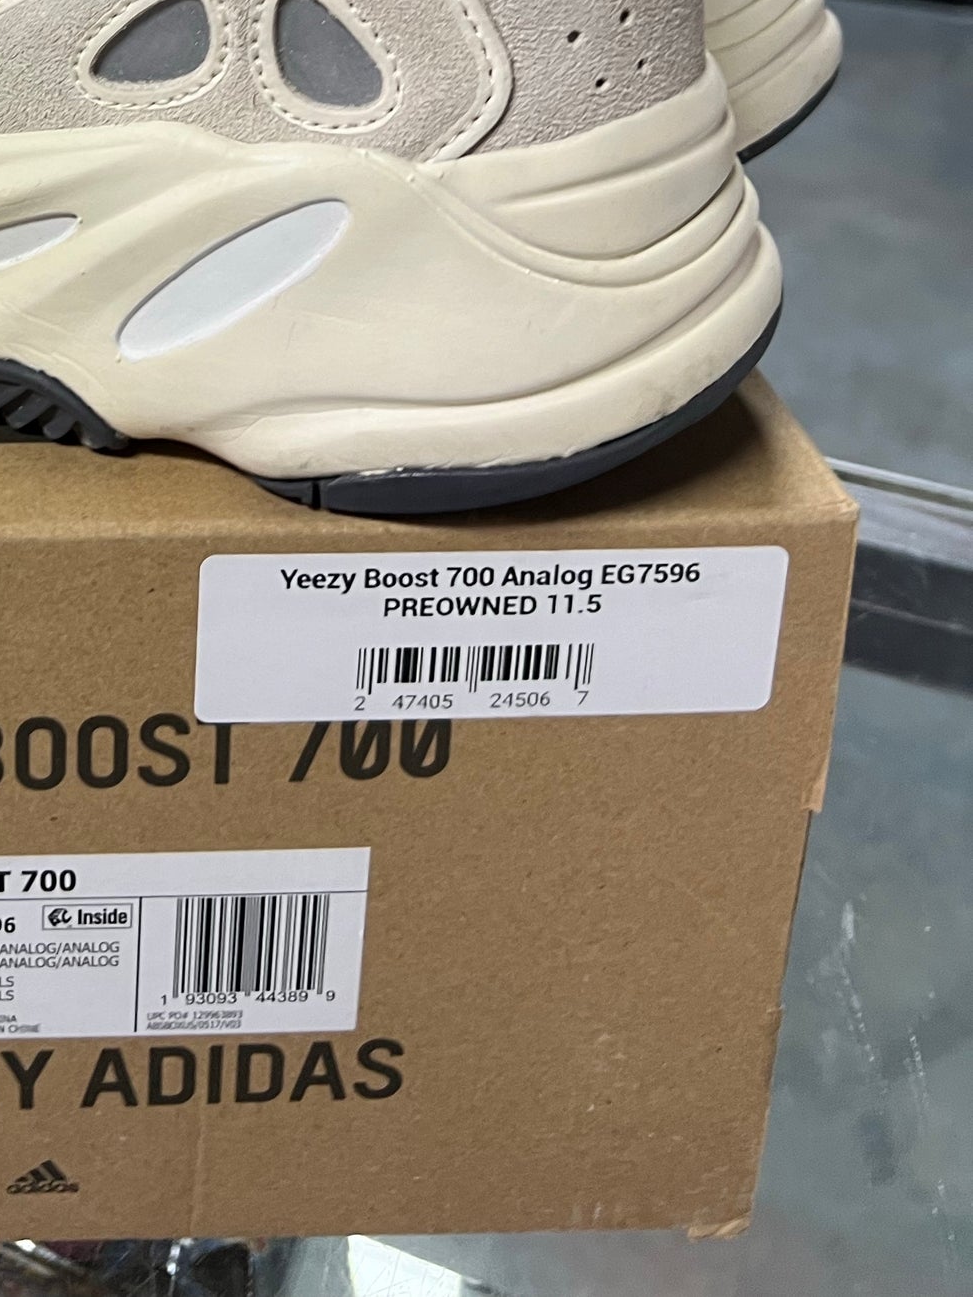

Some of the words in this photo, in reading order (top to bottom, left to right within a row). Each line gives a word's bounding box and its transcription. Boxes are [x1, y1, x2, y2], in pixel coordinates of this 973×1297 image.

[280, 566, 357, 594] Yeezy
[364, 566, 439, 590] Boost
[446, 565, 495, 588] 700
[502, 564, 594, 591] Analog
[600, 561, 701, 586] EG7596
[382, 595, 538, 618] PREOWNED
[546, 593, 603, 616] 11.5
[353, 695, 366, 712] 2
[391, 692, 454, 711] 47405
[489, 690, 552, 709] 24506
[576, 689, 590, 706] 7
[20, 869, 77, 892] 700
[77, 908, 128, 925] Inside
[160, 993, 167, 1006] 1
[185, 992, 238, 1006] 93093
[255, 990, 309, 1004] 44389
[325, 988, 336, 1002] 9
[80, 1038, 406, 1109] ADIDAS
